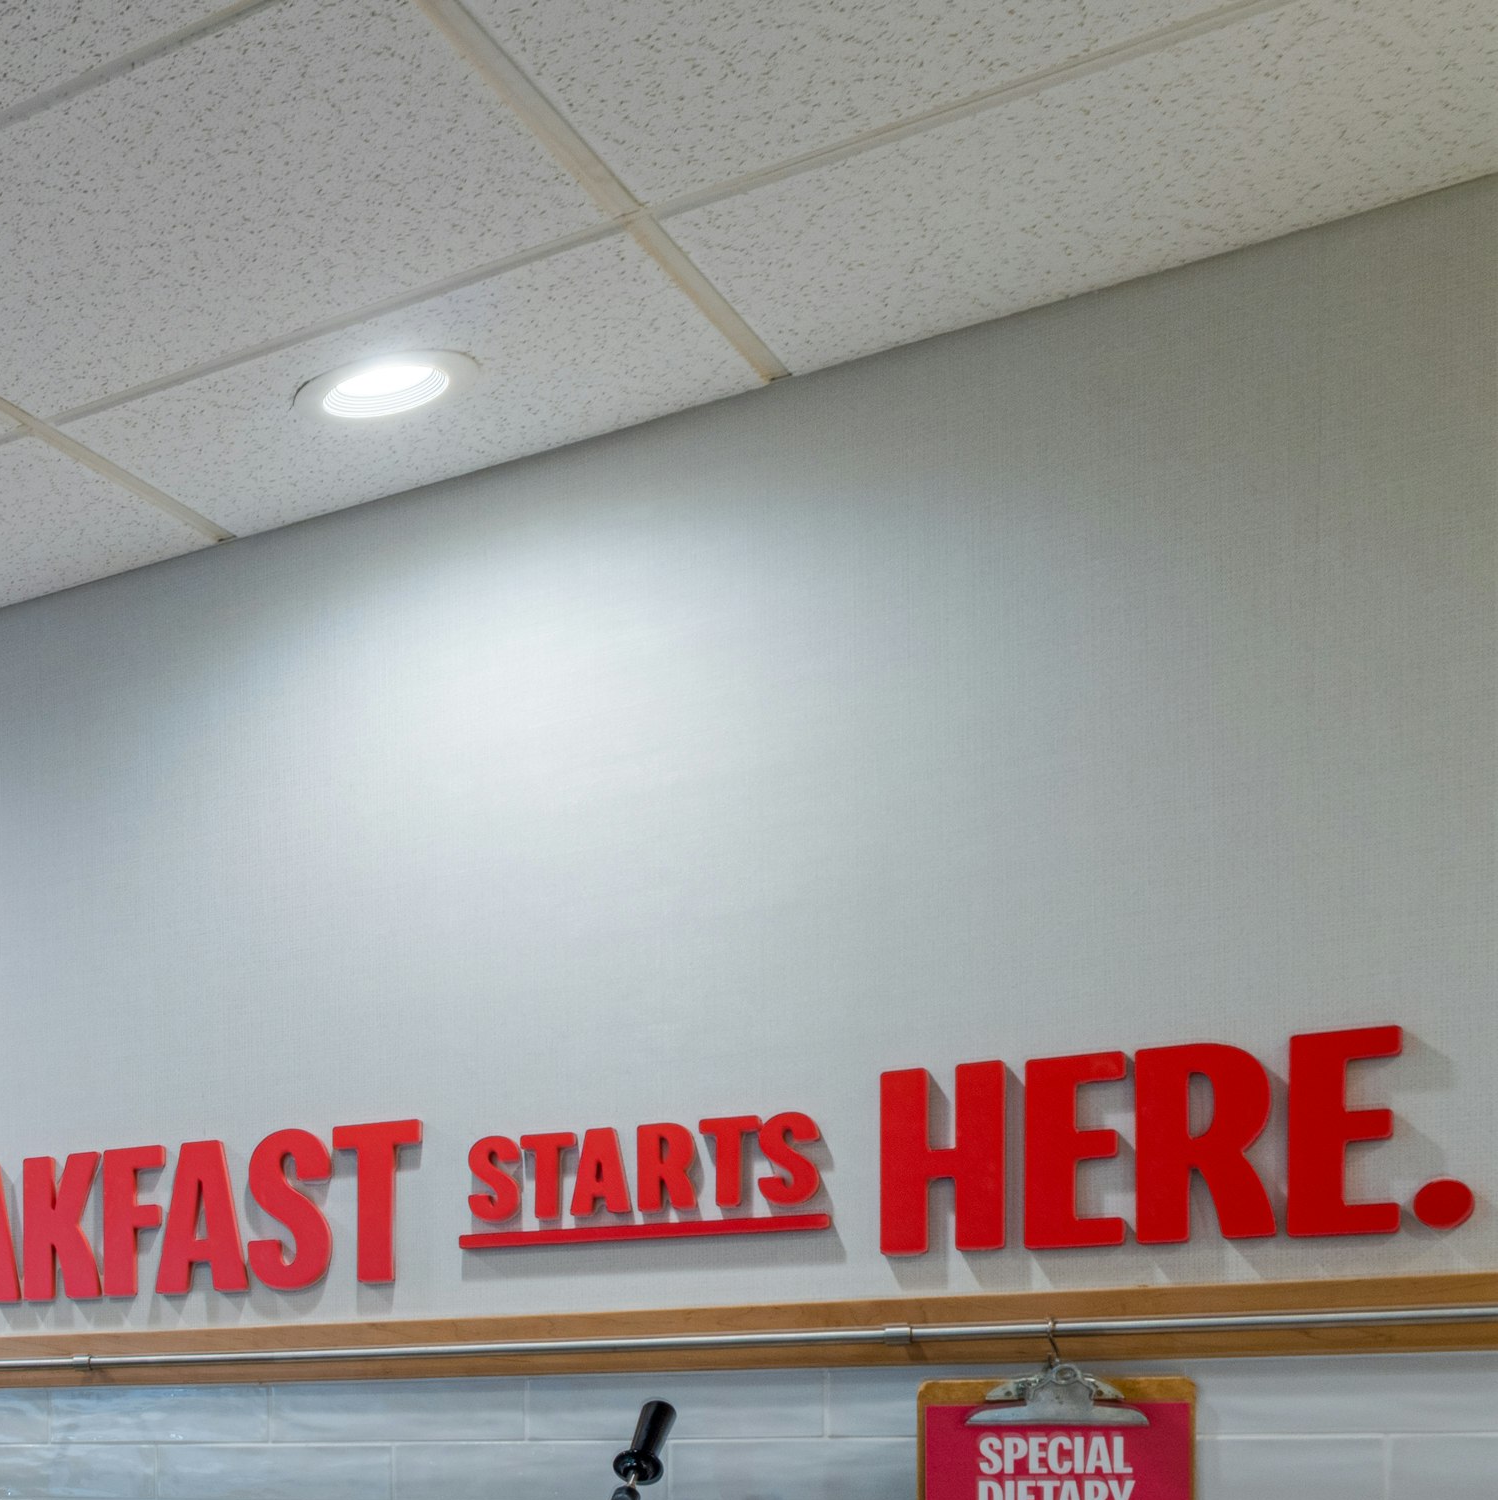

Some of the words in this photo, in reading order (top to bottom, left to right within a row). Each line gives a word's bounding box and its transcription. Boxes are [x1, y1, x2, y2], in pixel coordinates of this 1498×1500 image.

[467, 1111, 821, 1223] STARTS
[880, 1025, 1474, 1256] HERE.
[979, 1436, 1133, 1474] SPECIAL
